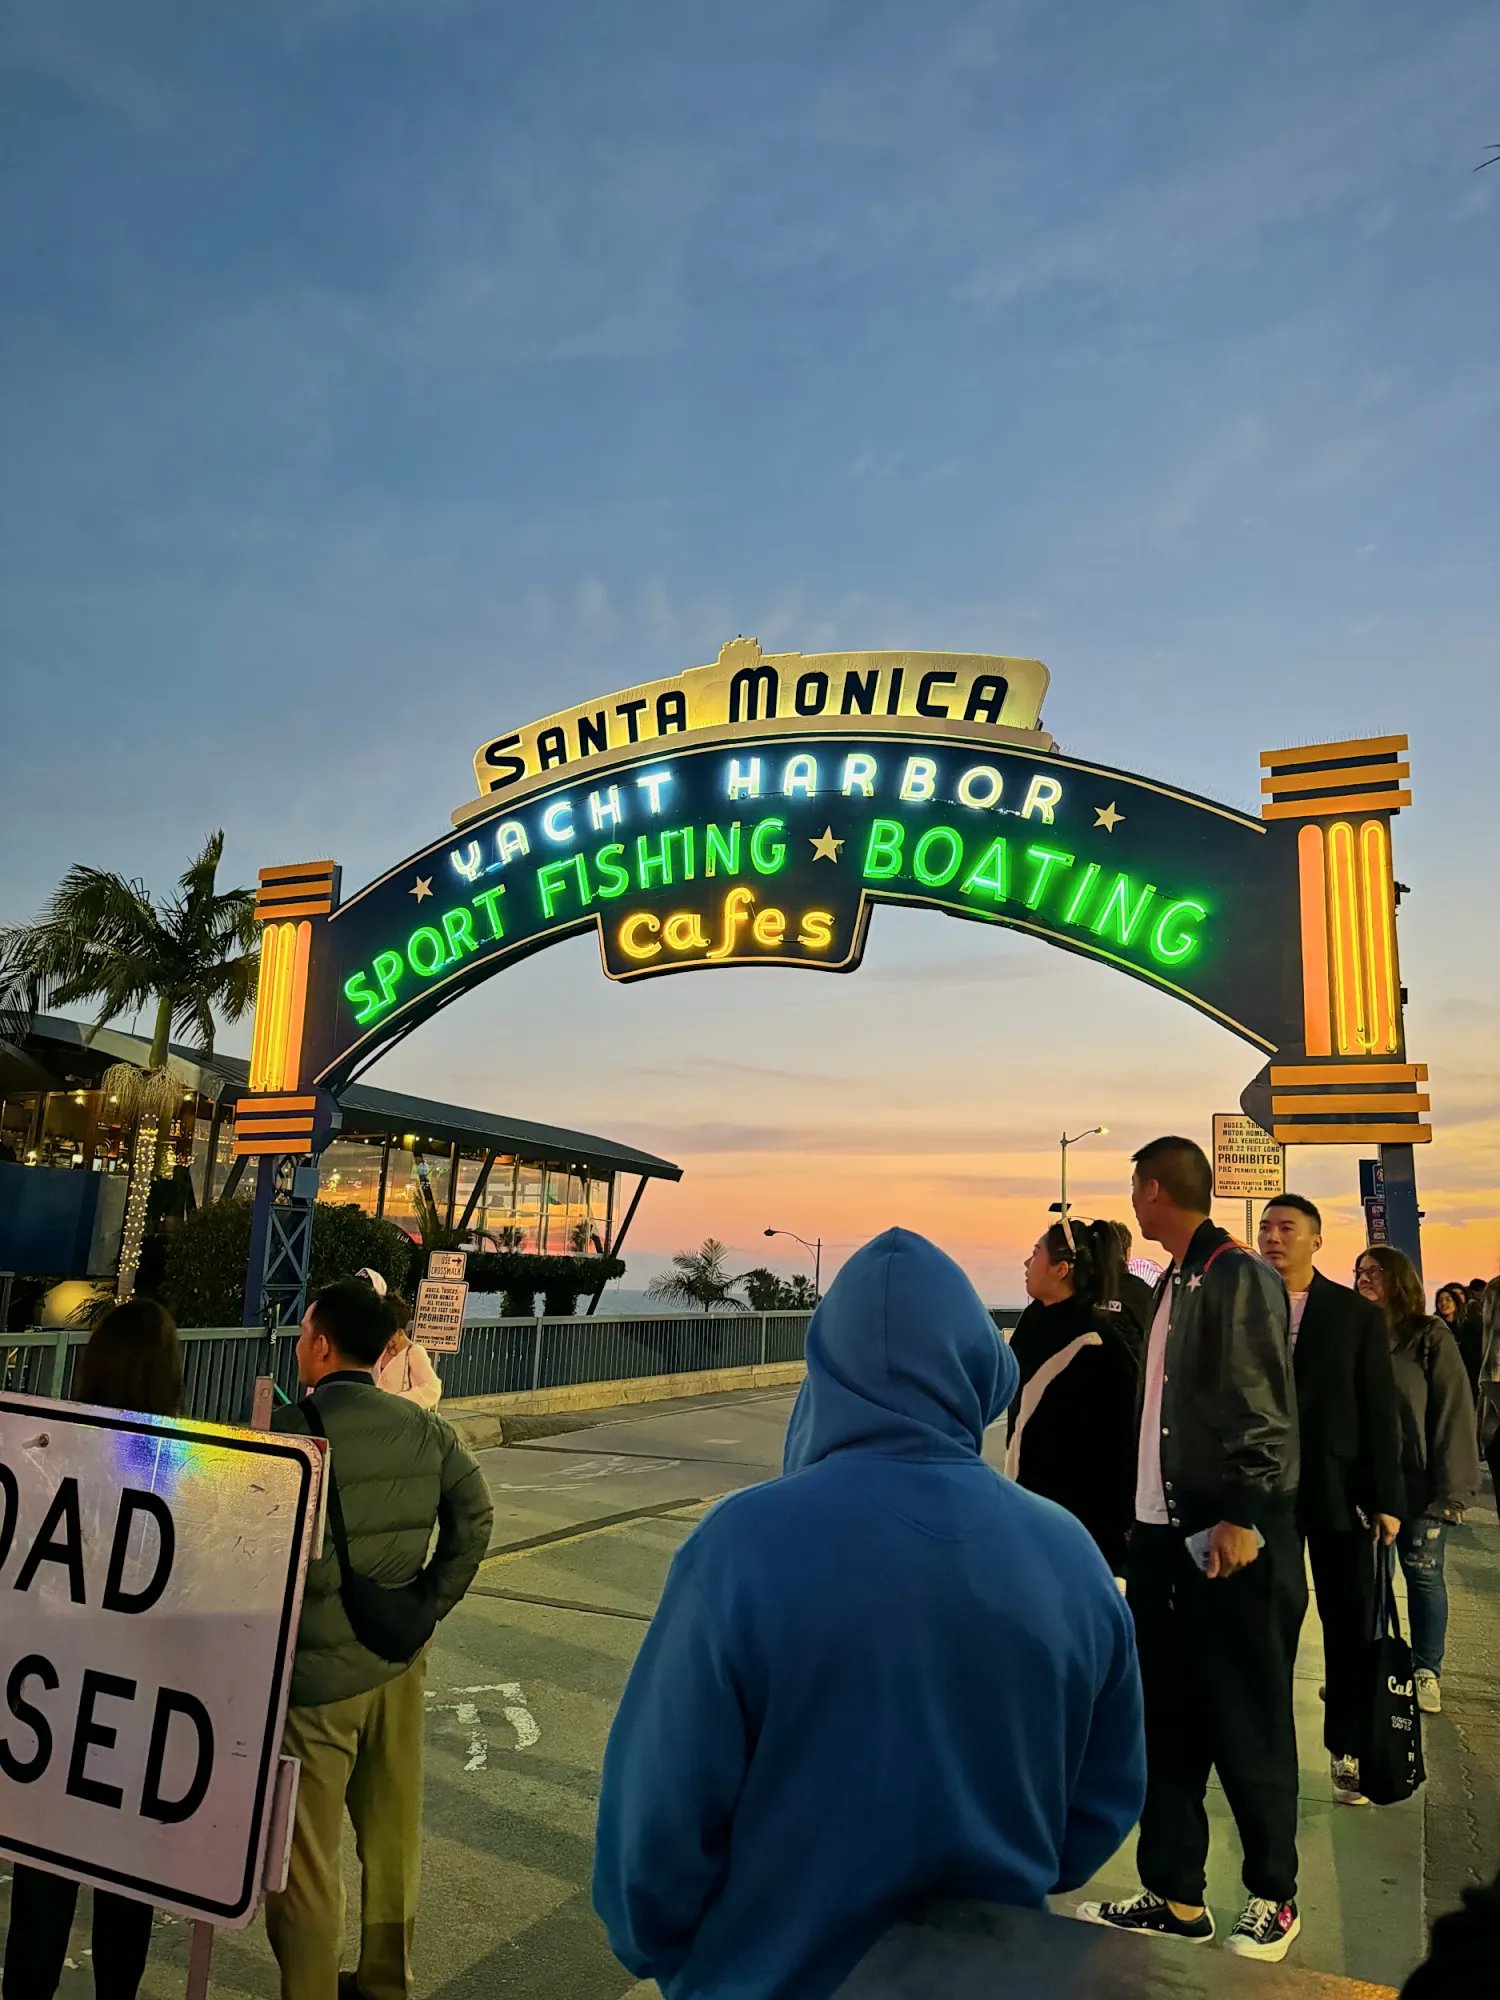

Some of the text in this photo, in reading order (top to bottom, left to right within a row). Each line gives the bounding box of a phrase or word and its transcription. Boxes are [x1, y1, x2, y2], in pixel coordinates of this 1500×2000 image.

[483, 665, 1009, 789] SANTA MONICA
[450, 753, 1063, 882] YACHT HARBOR
[344, 817, 1207, 1024] SPORT FISHING BOATING
[618, 886, 836, 959] cafes
[1218, 1153, 1280, 1165] PROHIBITED
[431, 1266, 461, 1276] CROSSWALK
[441, 1257, 451, 1265] USE
[418, 1313, 459, 1324] PROHIBITED
[0, 1462, 175, 1615] AD
